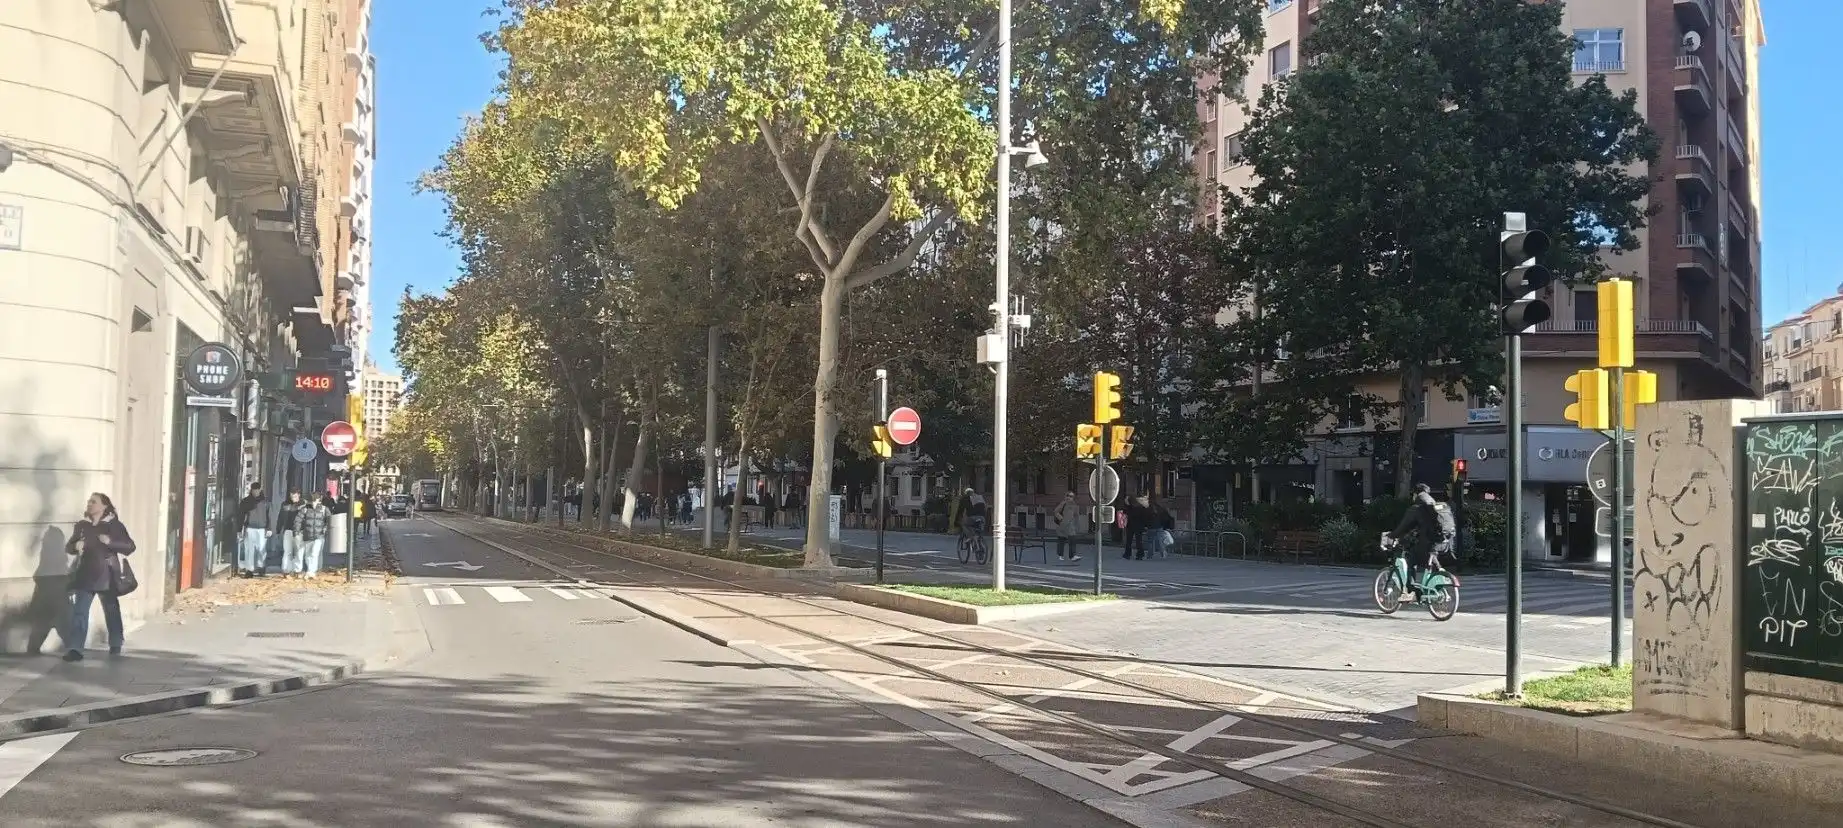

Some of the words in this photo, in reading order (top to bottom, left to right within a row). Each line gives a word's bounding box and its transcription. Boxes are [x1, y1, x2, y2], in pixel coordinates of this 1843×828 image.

[196, 364, 229, 375] PHONE
[199, 374, 226, 385] SHOP
[295, 375, 330, 389] 14:10
[1759, 616, 1808, 648] PIT
